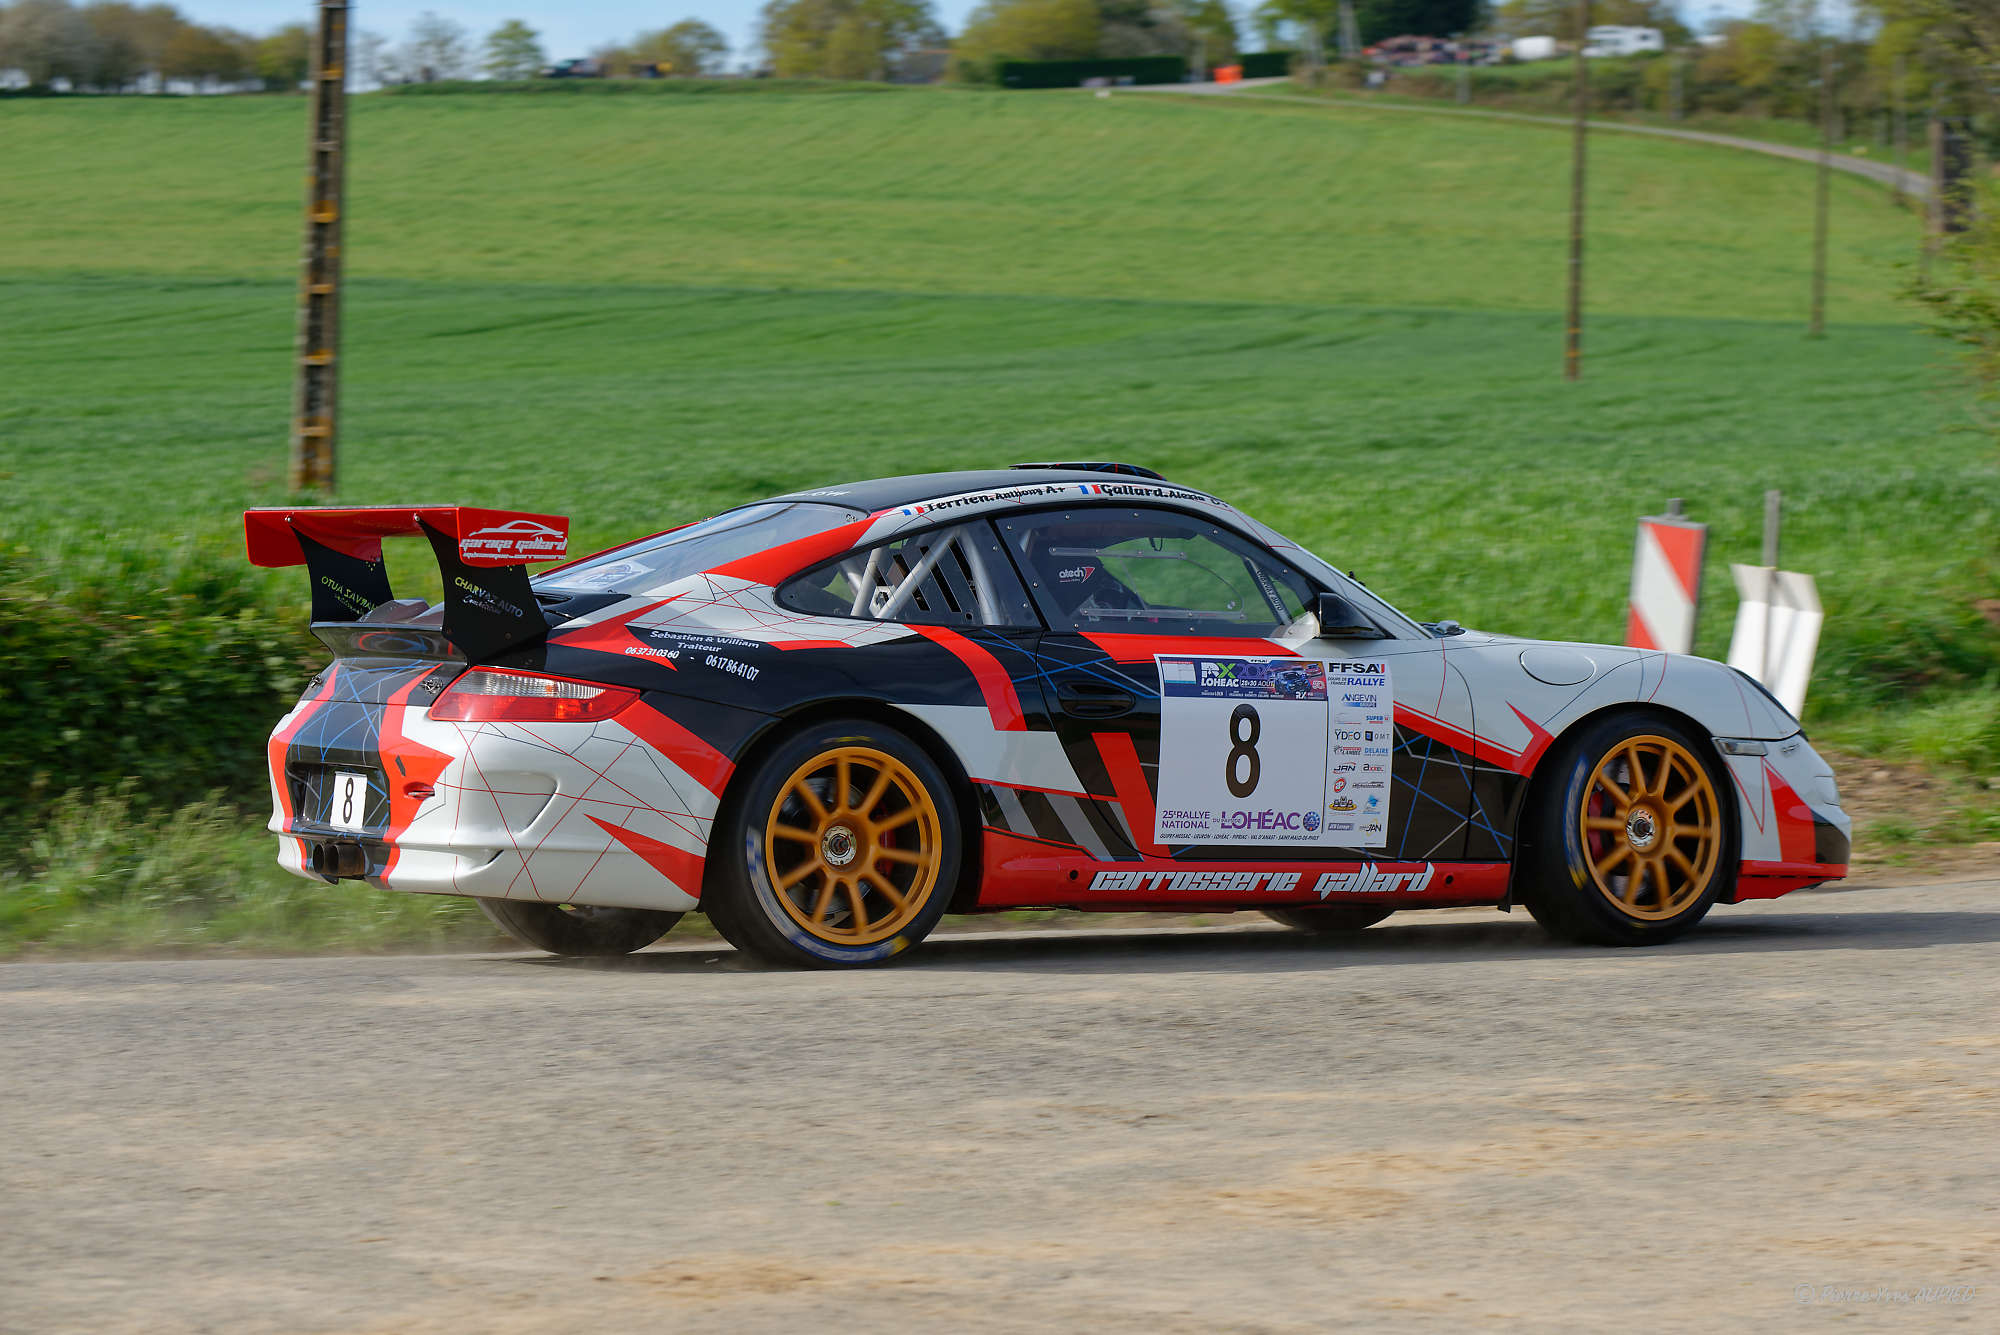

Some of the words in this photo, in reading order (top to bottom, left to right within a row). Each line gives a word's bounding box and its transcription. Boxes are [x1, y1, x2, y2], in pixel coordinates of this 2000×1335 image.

[460, 538, 514, 553] garage
[498, 600, 523, 617] AUTO
[650, 630, 703, 642] Sebastien
[705, 635, 714, 643] &
[716, 637, 760, 649] William
[677, 642, 722, 653] Traiteur
[624, 646, 680, 659] 0637310360
[705, 654, 760, 681] 0617864107
[1201, 662, 1236, 679] RX
[1329, 663, 1380, 673] FFSA
[1201, 678, 1239, 687] LOHEAC
[1347, 677, 1385, 686] RALLYE
[1341, 693, 1377, 702] ANGEVIN
[1226, 703, 1260, 798] 8
[343, 777, 354, 824] 8
[1176, 811, 1210, 819] RALLYE
[1221, 809, 1301, 830] LOHÉAC
[1161, 820, 1210, 829] NATIONAL
[1088, 871, 1302, 891] carrosserie
[1312, 862, 1435, 900] gallard
